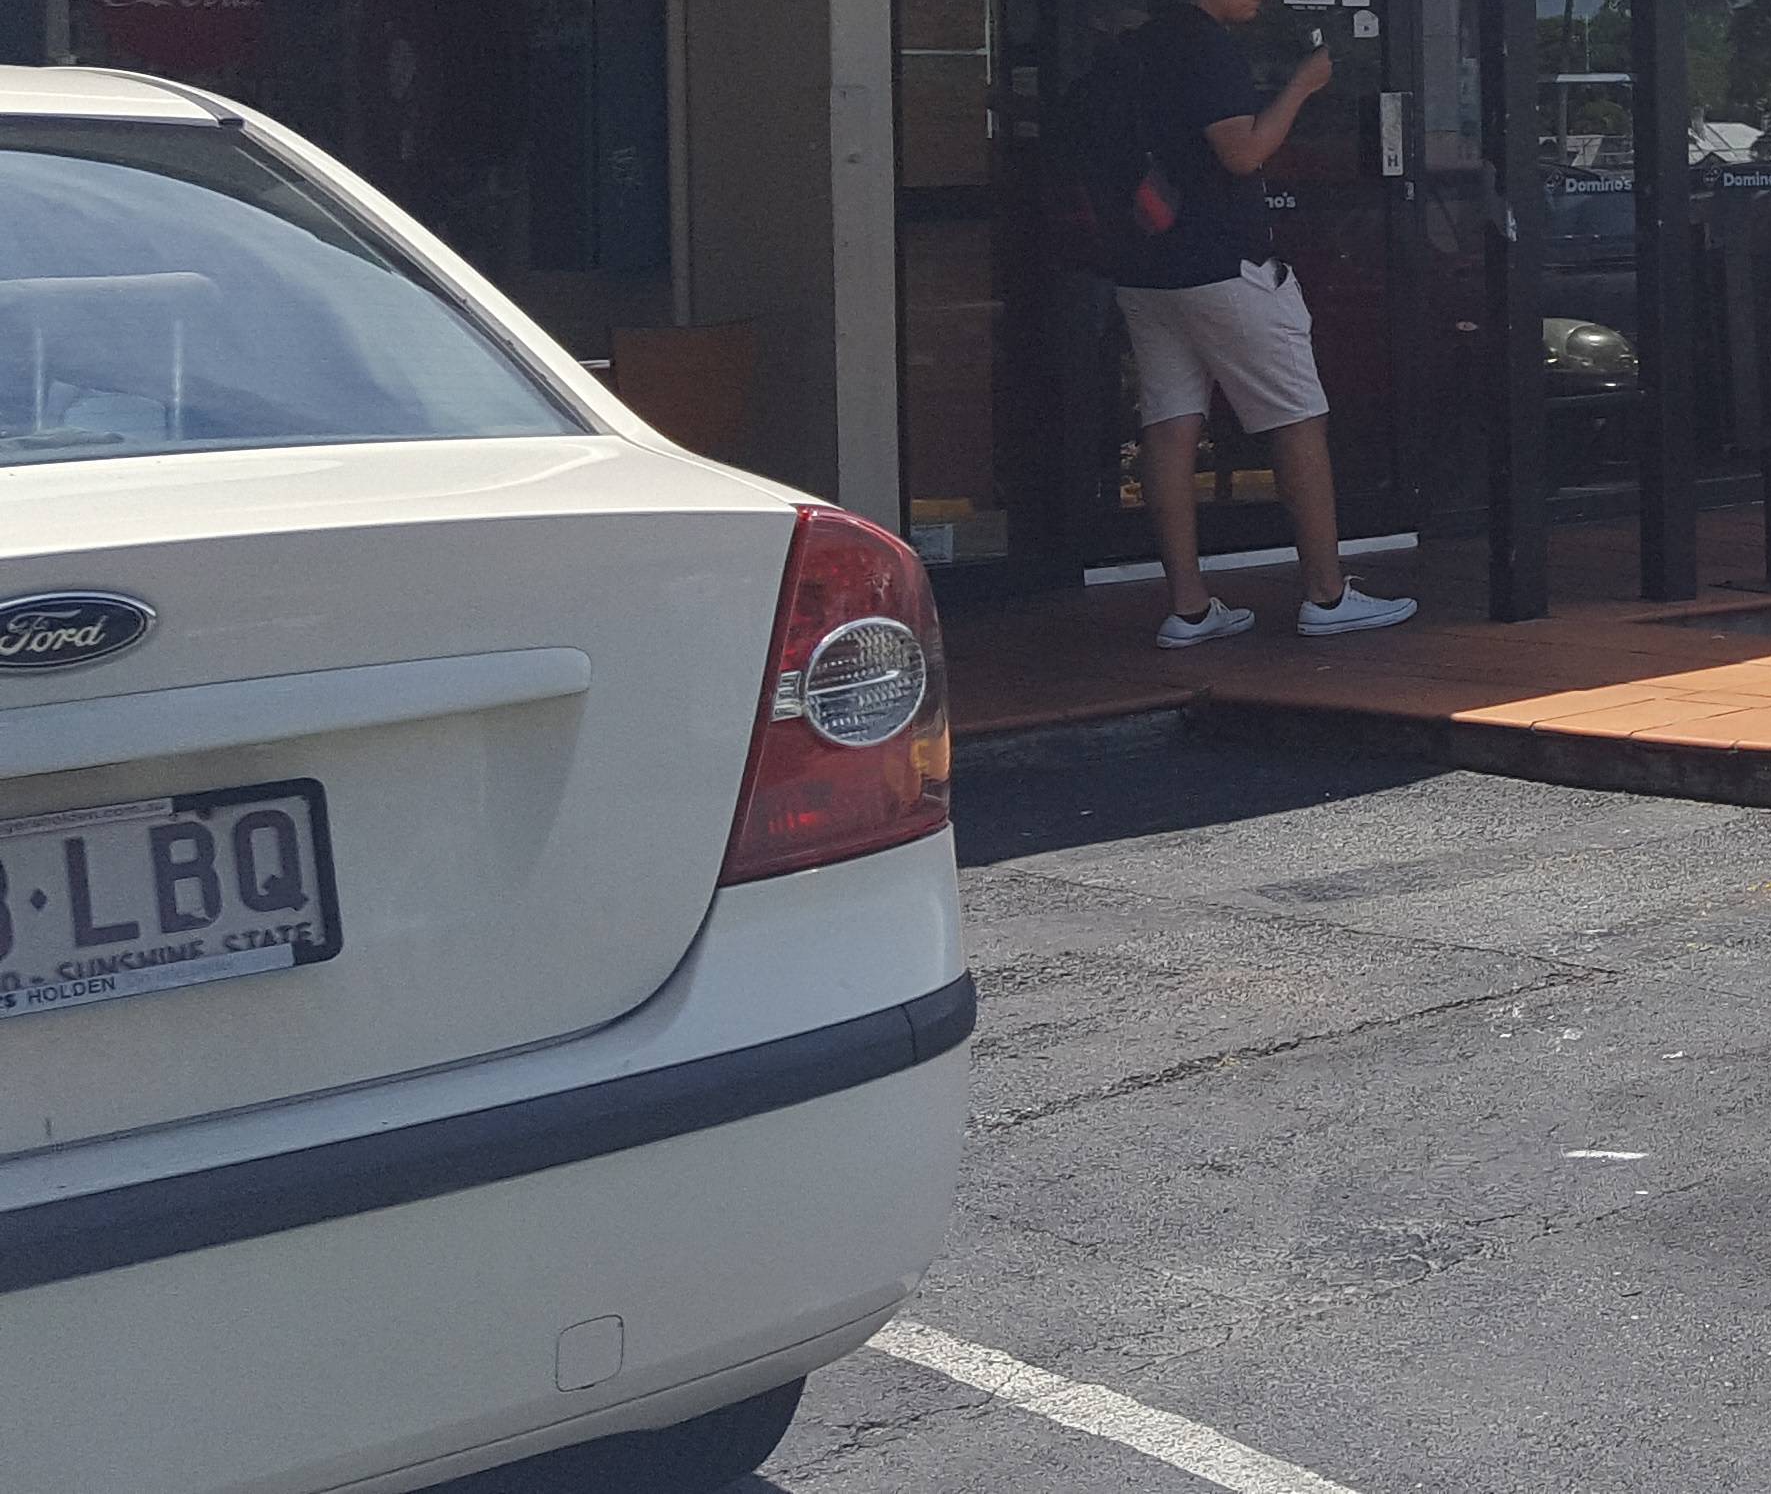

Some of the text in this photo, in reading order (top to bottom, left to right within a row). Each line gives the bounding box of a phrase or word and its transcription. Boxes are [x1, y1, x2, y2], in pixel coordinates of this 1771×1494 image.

[1564, 177, 1633, 194] Domino's
[0, 609, 109, 656] Ford
[28, 977, 117, 1005] HOLDEN
